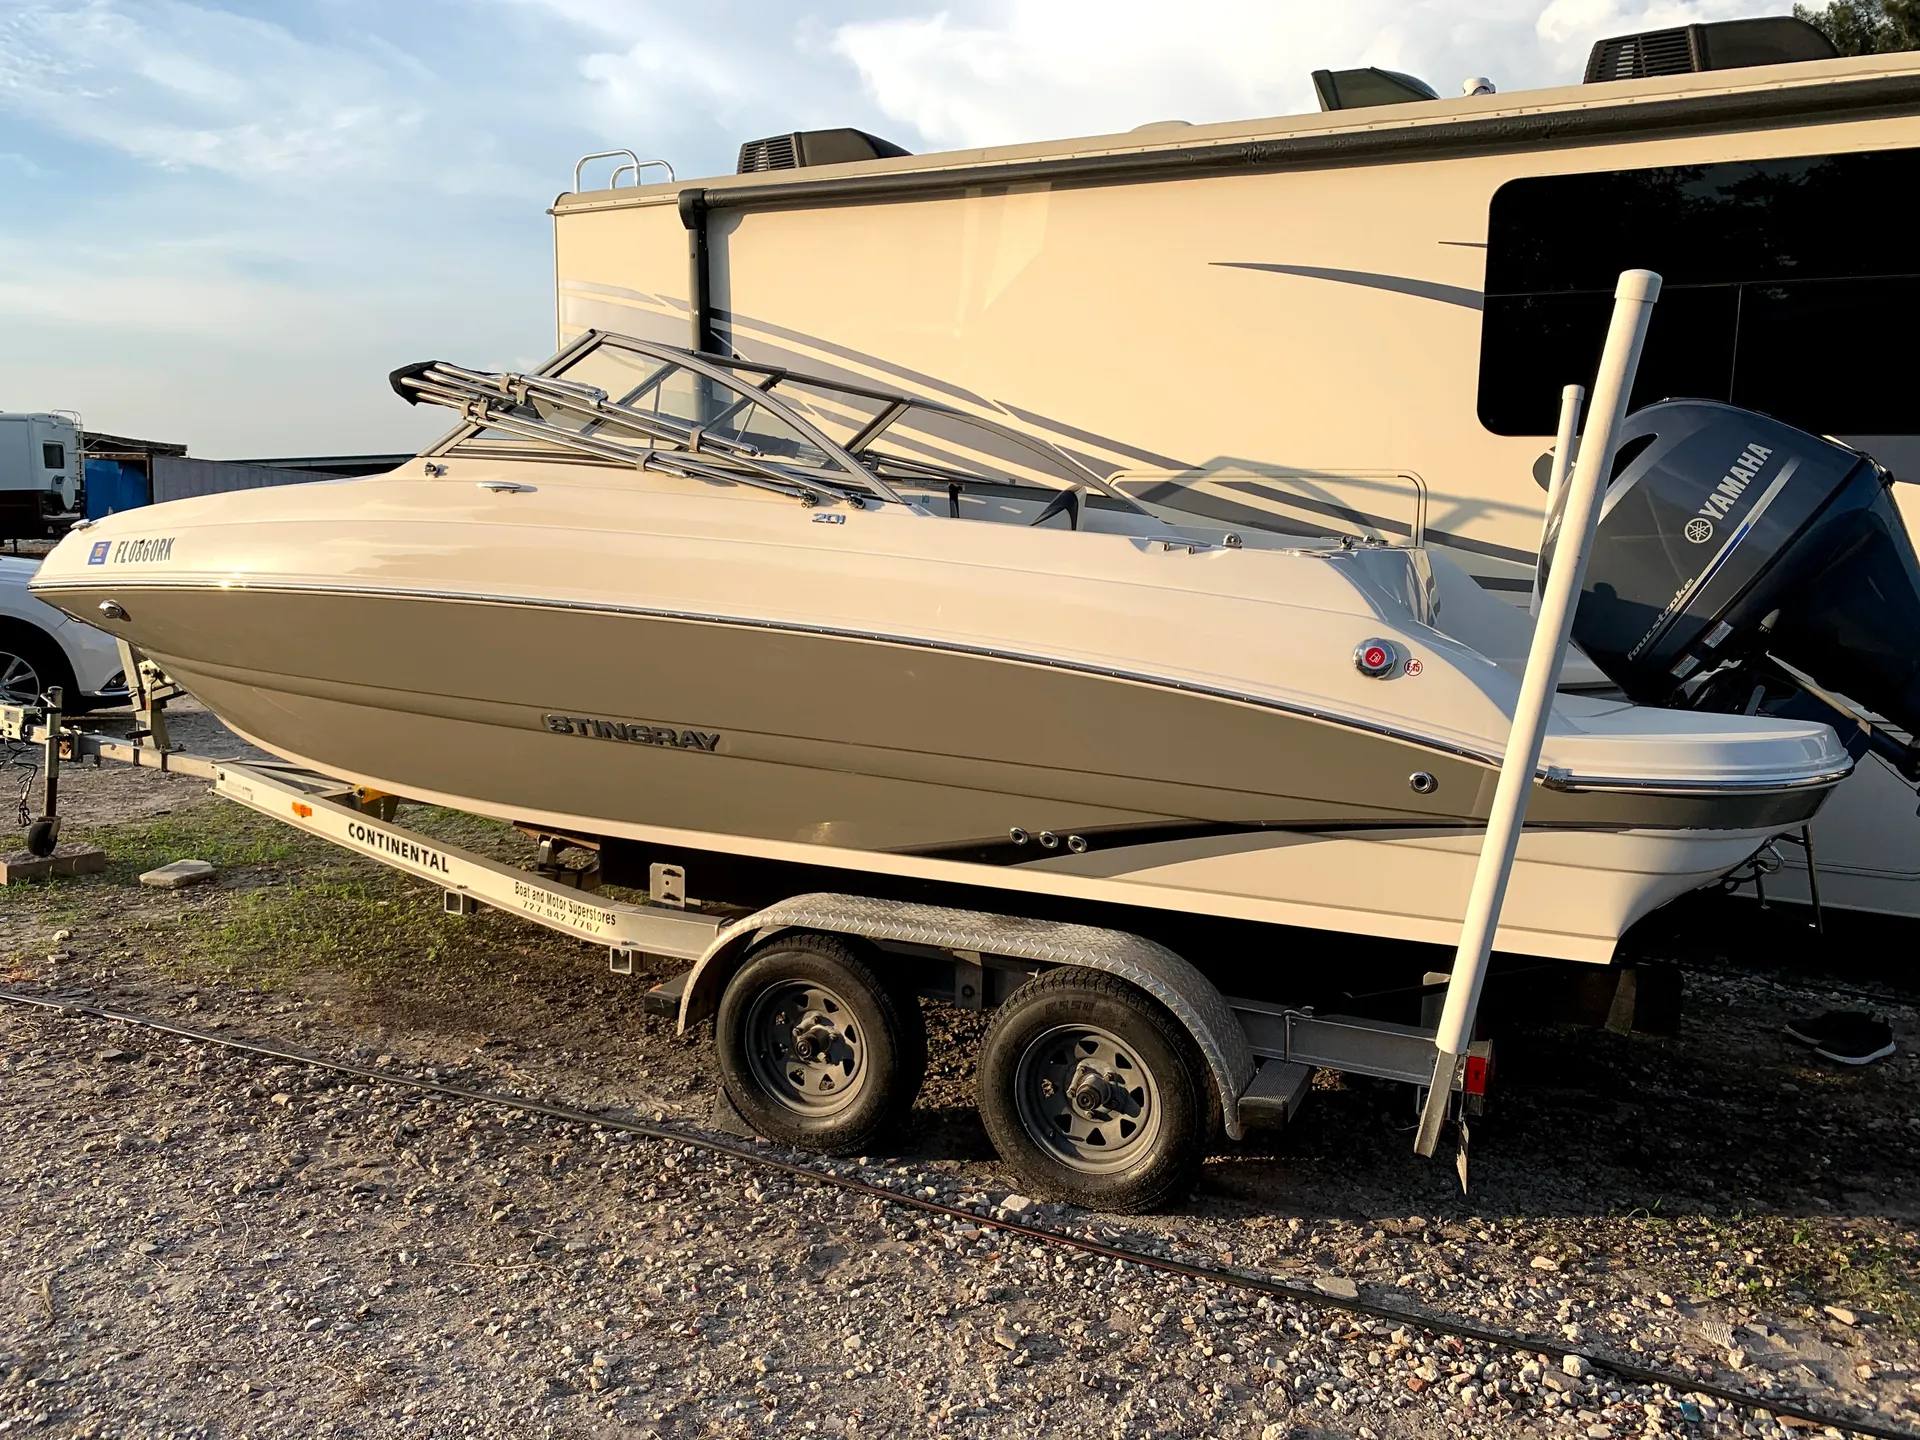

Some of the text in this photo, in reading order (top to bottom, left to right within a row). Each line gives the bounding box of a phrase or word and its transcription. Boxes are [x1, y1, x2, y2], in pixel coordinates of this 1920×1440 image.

[1698, 442, 1773, 520] YAMAHA
[547, 714, 720, 752] STINGRAY
[348, 822, 449, 874] CONTINENTAL
[514, 881, 616, 926] Boat and Motor Superstores
